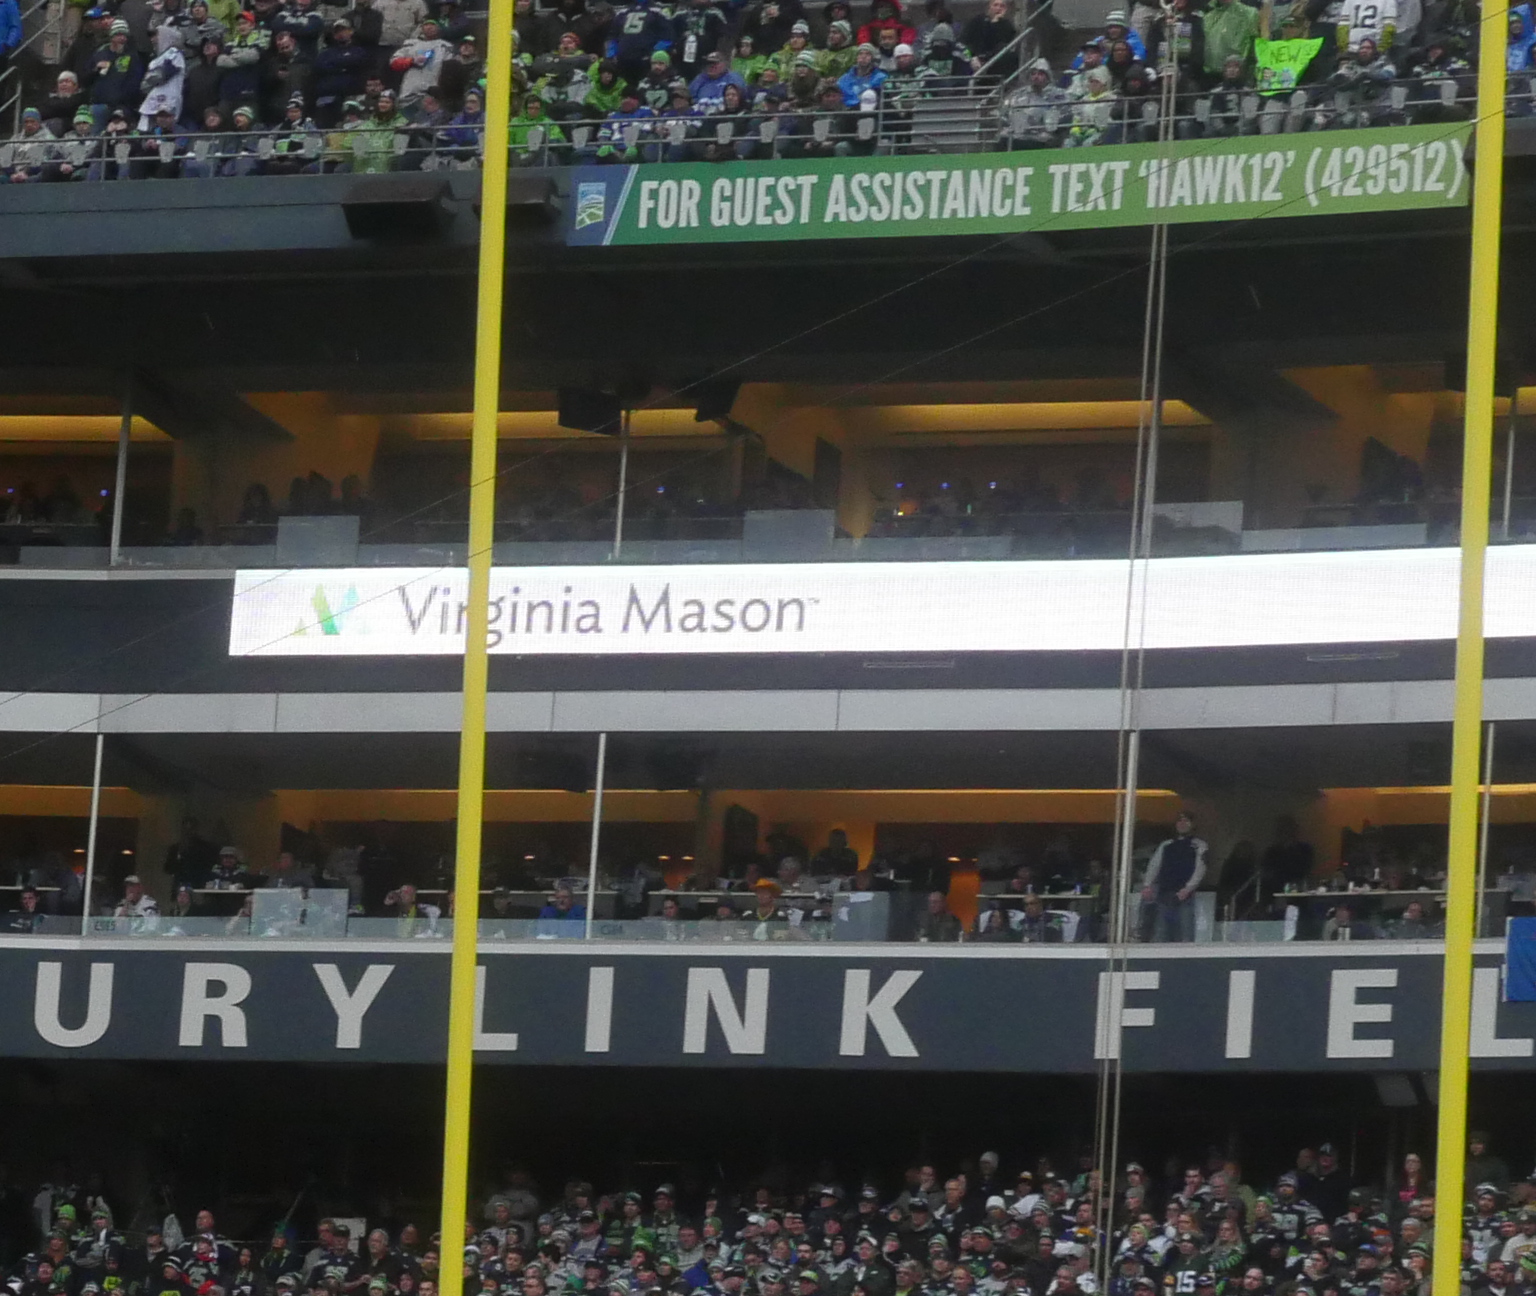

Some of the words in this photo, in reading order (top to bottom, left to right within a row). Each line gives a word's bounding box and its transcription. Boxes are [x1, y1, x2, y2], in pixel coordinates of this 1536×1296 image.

[623, 11, 647, 34] 15
[1353, 3, 1377, 29] 12
[638, 179, 702, 229] FOR
[710, 173, 818, 228] GUEST
[823, 165, 1035, 224] ASSISTANCE
[1048, 160, 1132, 214] TEXT
[1304, 136, 1465, 208] (429512)
[398, 584, 603, 649] Virginia
[621, 582, 806, 634] Mason
[1176, 1270, 1197, 1293] 15
